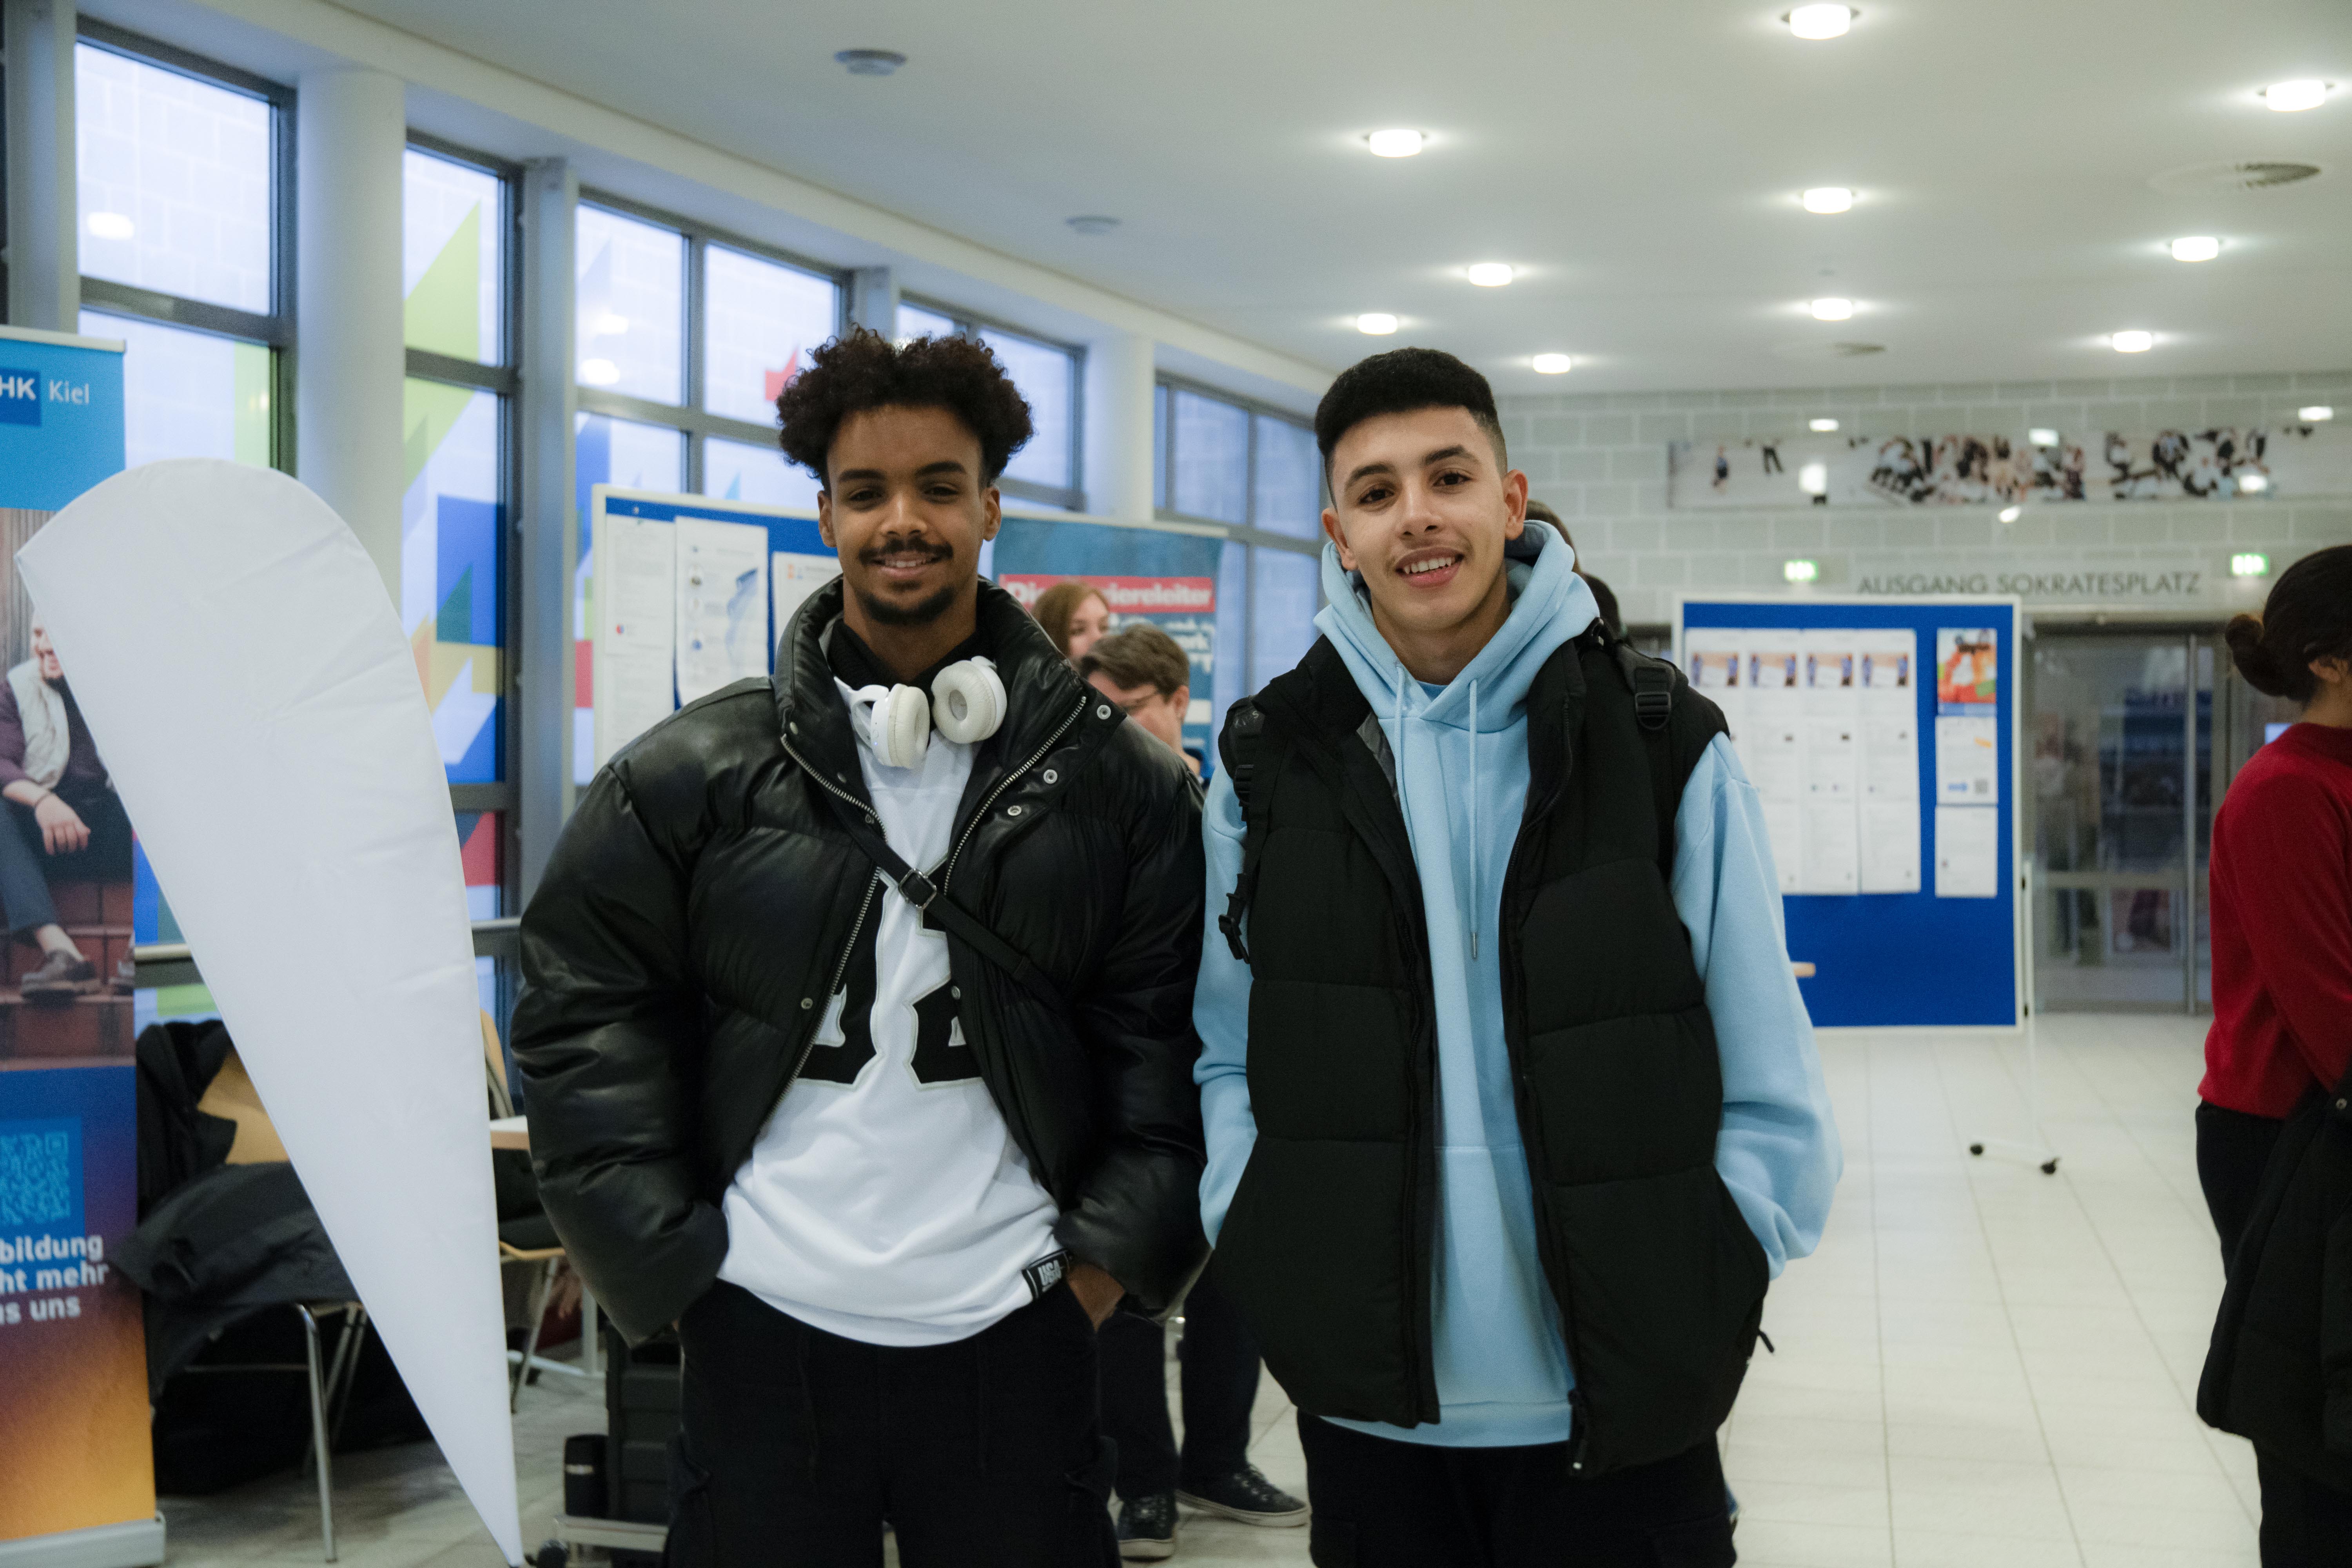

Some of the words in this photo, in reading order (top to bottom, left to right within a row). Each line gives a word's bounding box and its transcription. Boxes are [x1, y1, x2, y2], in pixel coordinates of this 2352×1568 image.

[49, 379, 89, 405] Kiel
[1857, 574, 1988, 594] AUSGANG
[1997, 571, 2201, 596] SOKRATESPLATZ
[36, 1260, 109, 1290] mehr
[30, 1296, 81, 1320] uns
